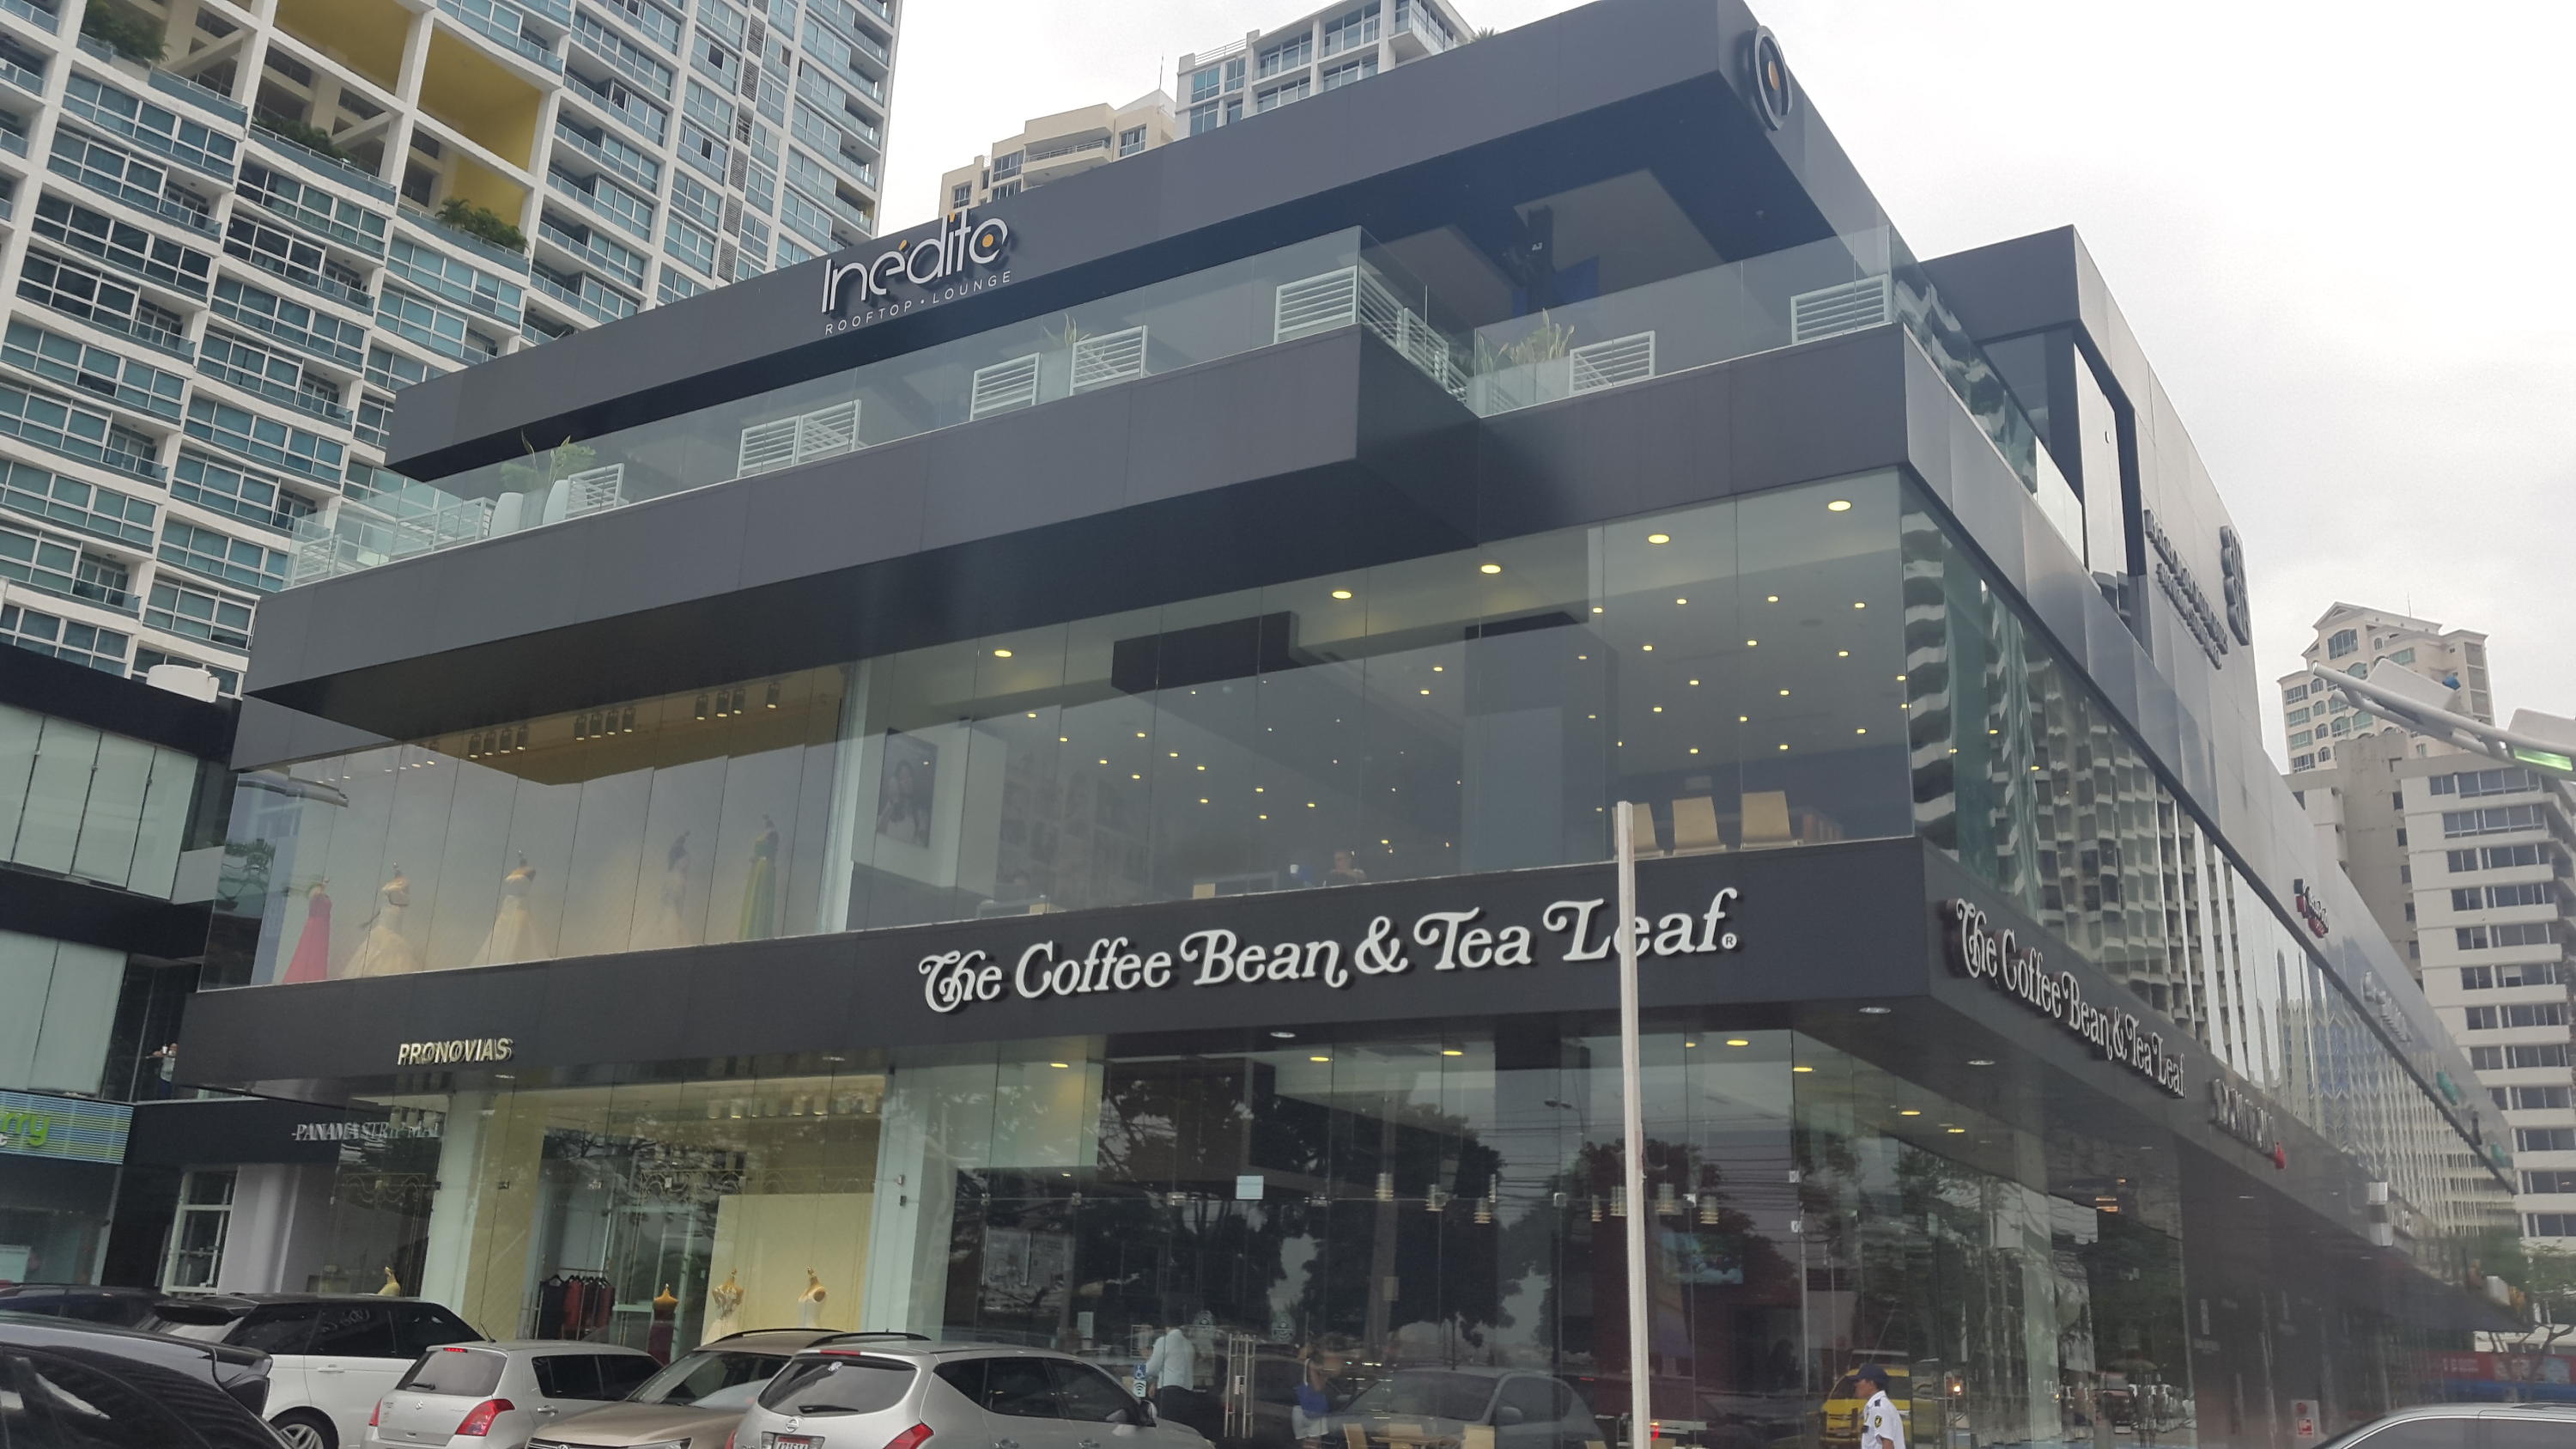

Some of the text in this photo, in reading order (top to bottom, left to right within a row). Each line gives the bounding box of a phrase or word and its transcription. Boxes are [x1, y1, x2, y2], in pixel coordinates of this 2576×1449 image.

[825, 271, 1012, 335] ROOFTOP LOUNGE
[919, 950, 1003, 1013] The
[1015, 936, 1172, 998] Coffee
[1180, 928, 1348, 988] Bean
[1354, 916, 1409, 974] &
[1413, 907, 1532, 971] Tea
[1956, 898, 2187, 1099] The Coffee Bean & Tea Leaf
[398, 1037, 513, 1066] PRONOVIAS
